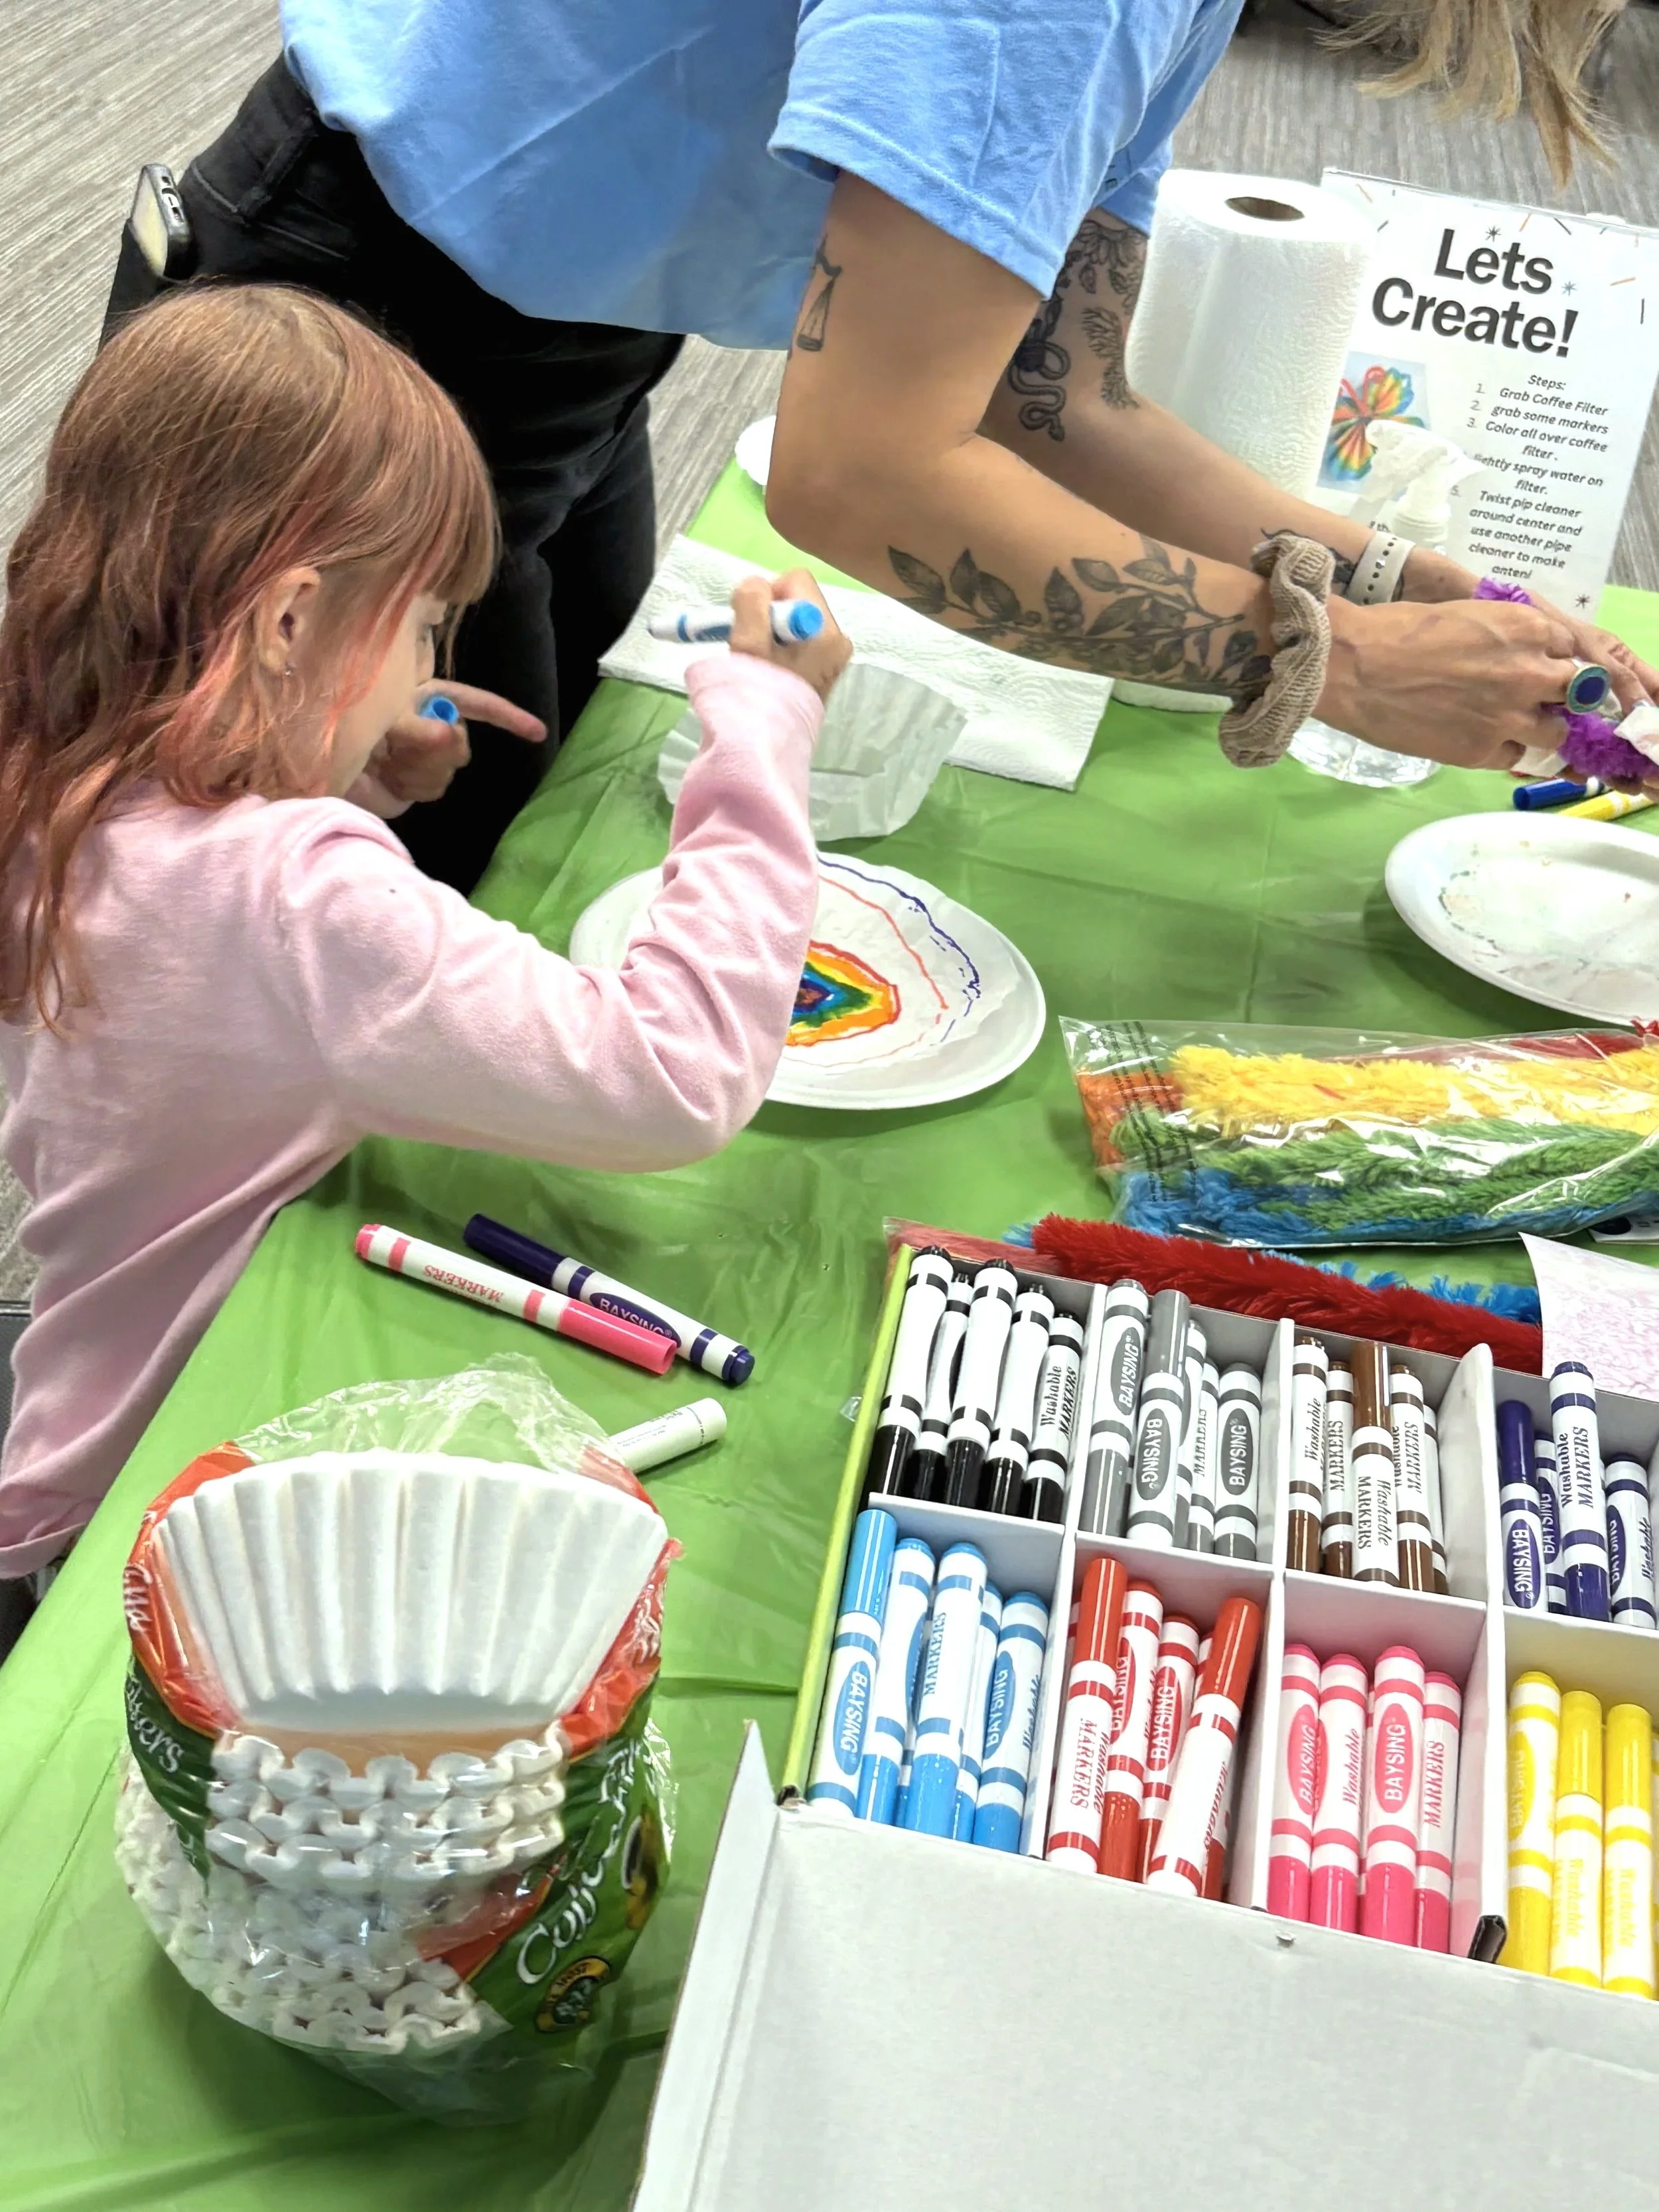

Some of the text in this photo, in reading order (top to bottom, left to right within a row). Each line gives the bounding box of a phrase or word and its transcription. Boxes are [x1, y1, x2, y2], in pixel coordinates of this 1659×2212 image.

[1433, 228, 1555, 295] Lets
[1372, 277, 1579, 358] Create!
[1500, 388, 1530, 402] Grab
[1532, 394, 1573, 409] Coffee
[1574, 401, 1609, 415] Filter
[1528, 374, 1566, 391] Steps:
[1486, 421, 1520, 435] Color
[1520, 428, 1537, 439] all
[1538, 431, 1567, 444] over
[1569, 435, 1609, 453] coffee
[1491, 405, 1521, 418] grab
[1523, 411, 1556, 425] some
[1558, 418, 1609, 435] markers
[1479, 490, 1512, 506] Twist
[1511, 498, 1533, 510] pip
[1535, 502, 1582, 518] cleaner
[1512, 463, 1548, 479] spray
[1550, 471, 1586, 484] water
[1587, 477, 1603, 487] on
[1514, 479, 1548, 495] filter.
[1468, 542, 1566, 569] cleaner to make
[1469, 508, 1583, 537] around center and
[1470, 526, 1572, 553] use another pipe
[1304, 1398, 1322, 1461] Washable
[1328, 1420, 1344, 1491] MARKERS
[1404, 1422, 1422, 1495] MARKERS
[1557, 1432, 1573, 1509] Washable
[1573, 1426, 1593, 1509] MARKERS
[1358, 1476, 1372, 1550] MARKERS
[1376, 1479, 1393, 1546] Washable
[923, 1612, 946, 1696] MARKERS
[1070, 1719, 1097, 1809] MARKERS
[1342, 1728, 1360, 1806] Washable
[1423, 1741, 1445, 1828] MARKERS
